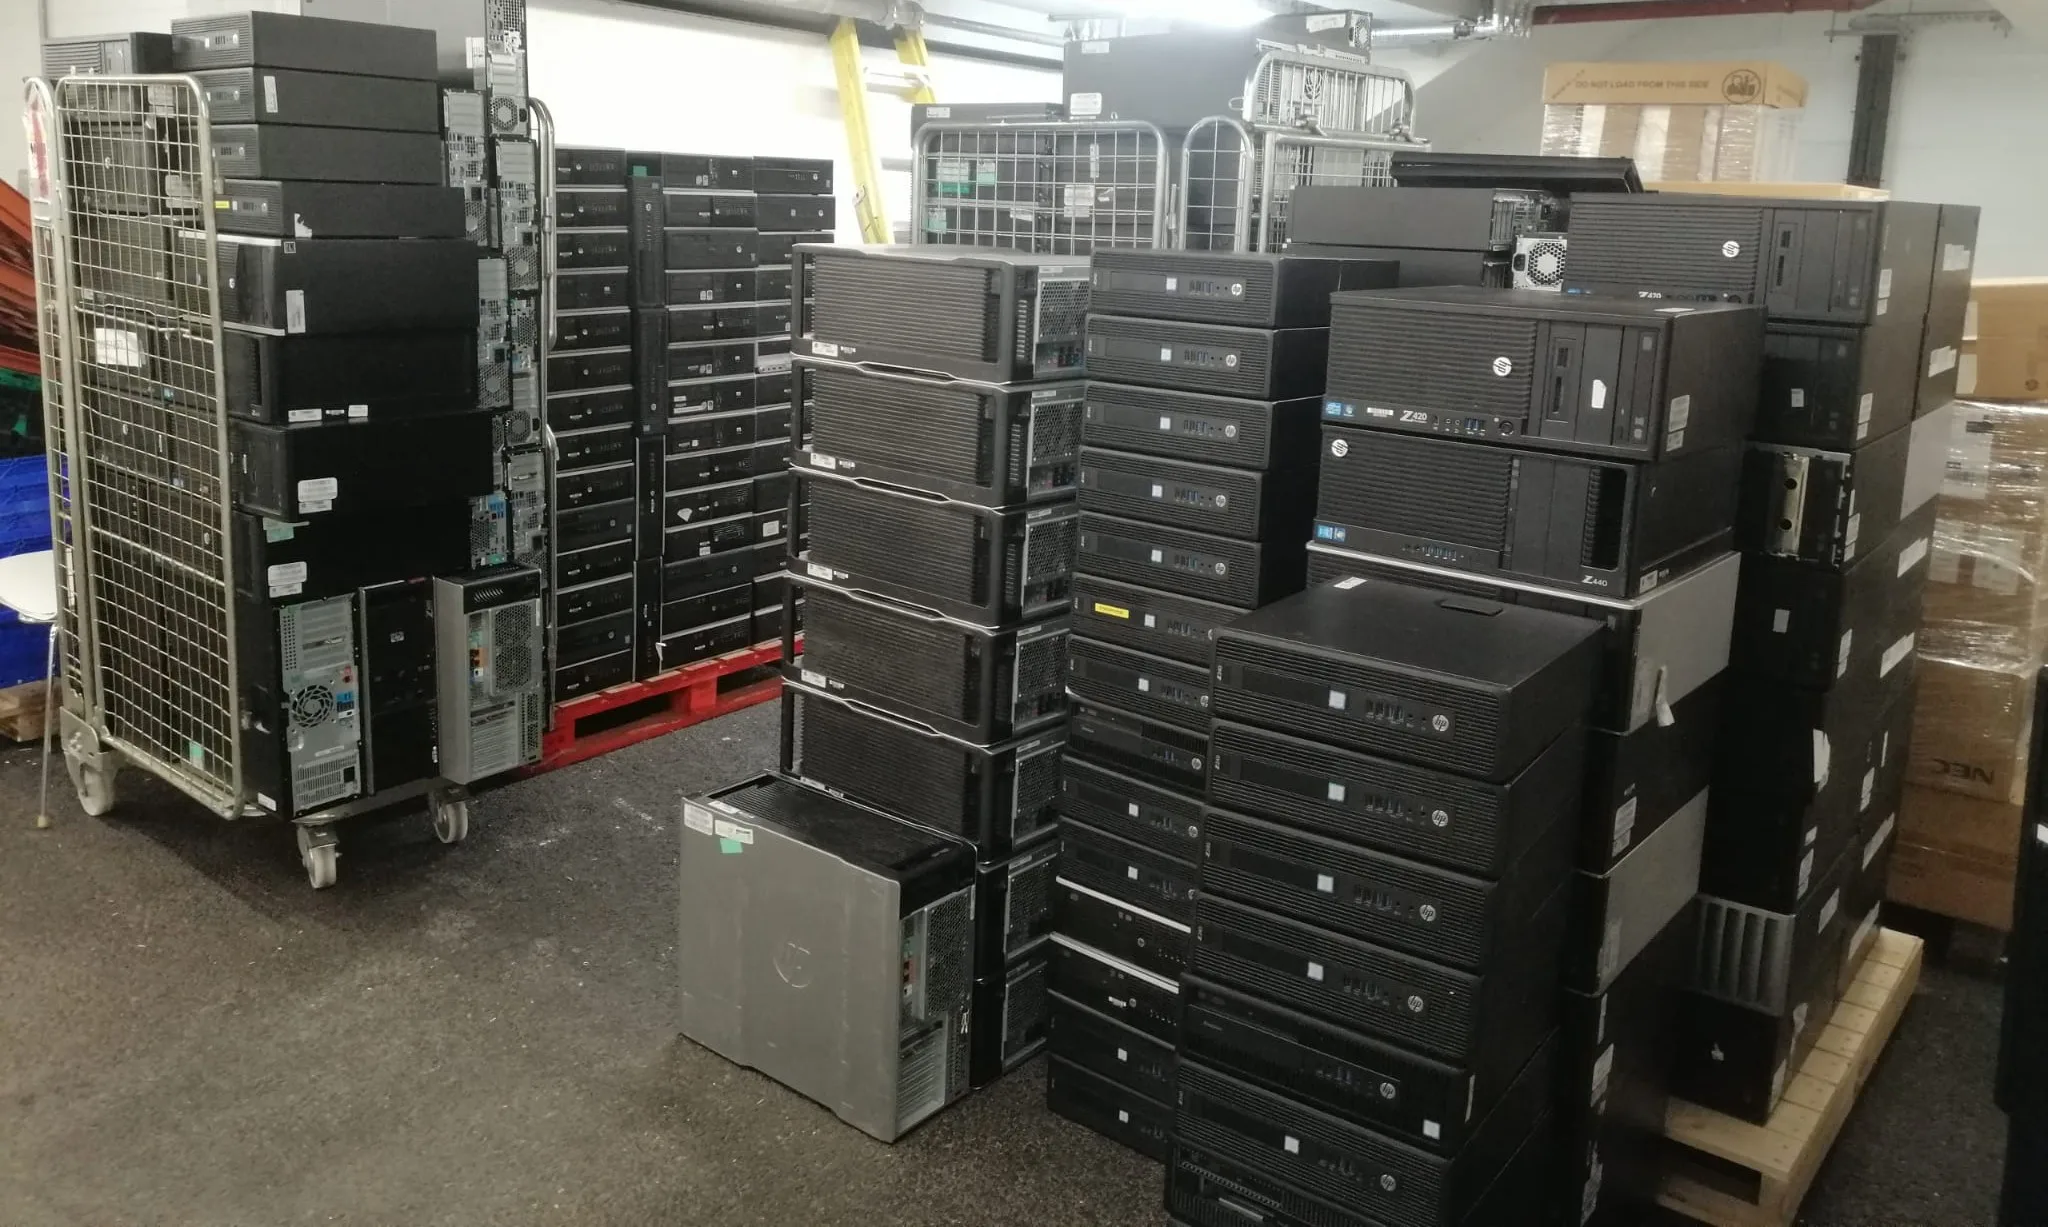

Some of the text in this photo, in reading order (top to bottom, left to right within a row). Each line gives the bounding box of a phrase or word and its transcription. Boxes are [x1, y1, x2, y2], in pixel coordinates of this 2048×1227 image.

[1590, 80, 1608, 89] NOT
[1609, 80, 1635, 89] LOAD
[1637, 80, 1663, 89] FROM
[1665, 80, 1686, 89] THIS
[1400, 410, 1428, 422] Z420
[1582, 574, 1608, 587] Z440
[1432, 714, 1450, 731] hp
[1931, 758, 1995, 785] NEC
[1431, 809, 1449, 827] hp
[1419, 904, 1436, 922] hp
[1407, 995, 1424, 1012] hp
